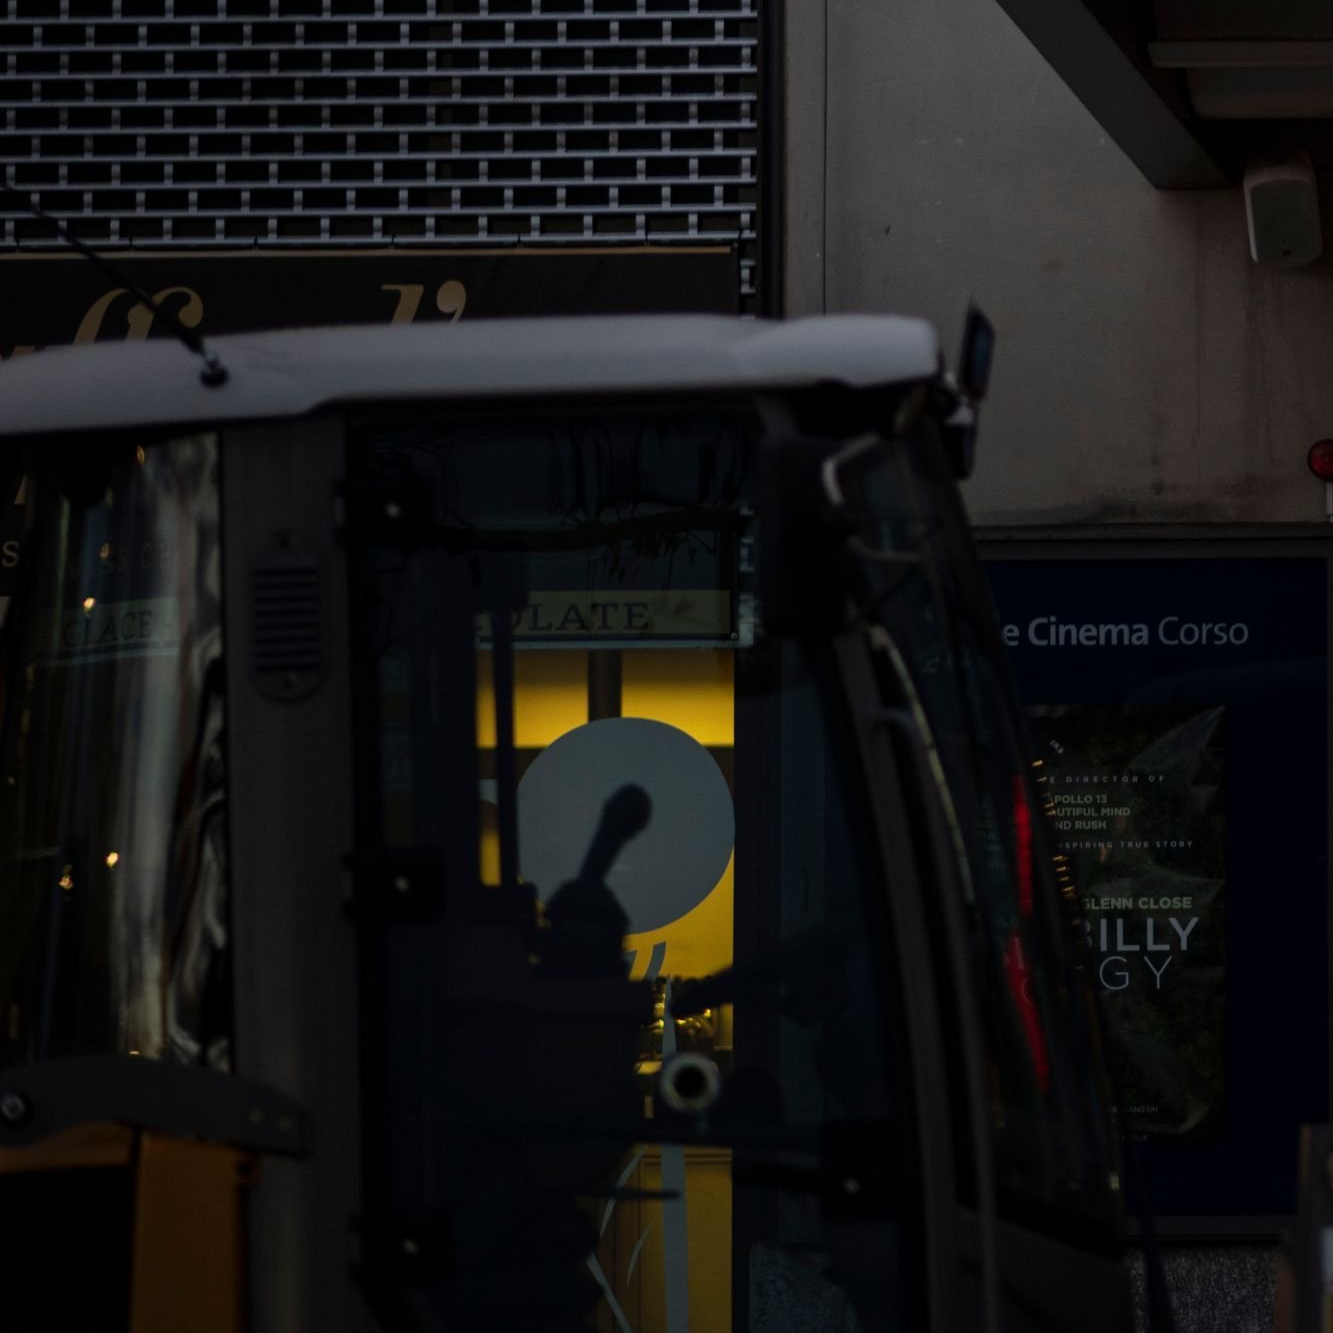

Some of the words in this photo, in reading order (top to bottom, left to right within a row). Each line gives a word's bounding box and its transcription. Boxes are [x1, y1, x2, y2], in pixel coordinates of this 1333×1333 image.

[1027, 615, 1150, 647] Cinema
[1157, 615, 1249, 646] Corso
[1065, 775, 1139, 784] DIRECTOR
[1147, 774, 1165, 783] OF
[1096, 794, 1108, 804] 13
[1100, 806, 1131, 817] MIND
[1074, 819, 1107, 830] RUSH
[1119, 841, 1149, 849] TRUE
[1155, 840, 1193, 849] STORY
[1138, 896, 1193, 910] CLOSE
